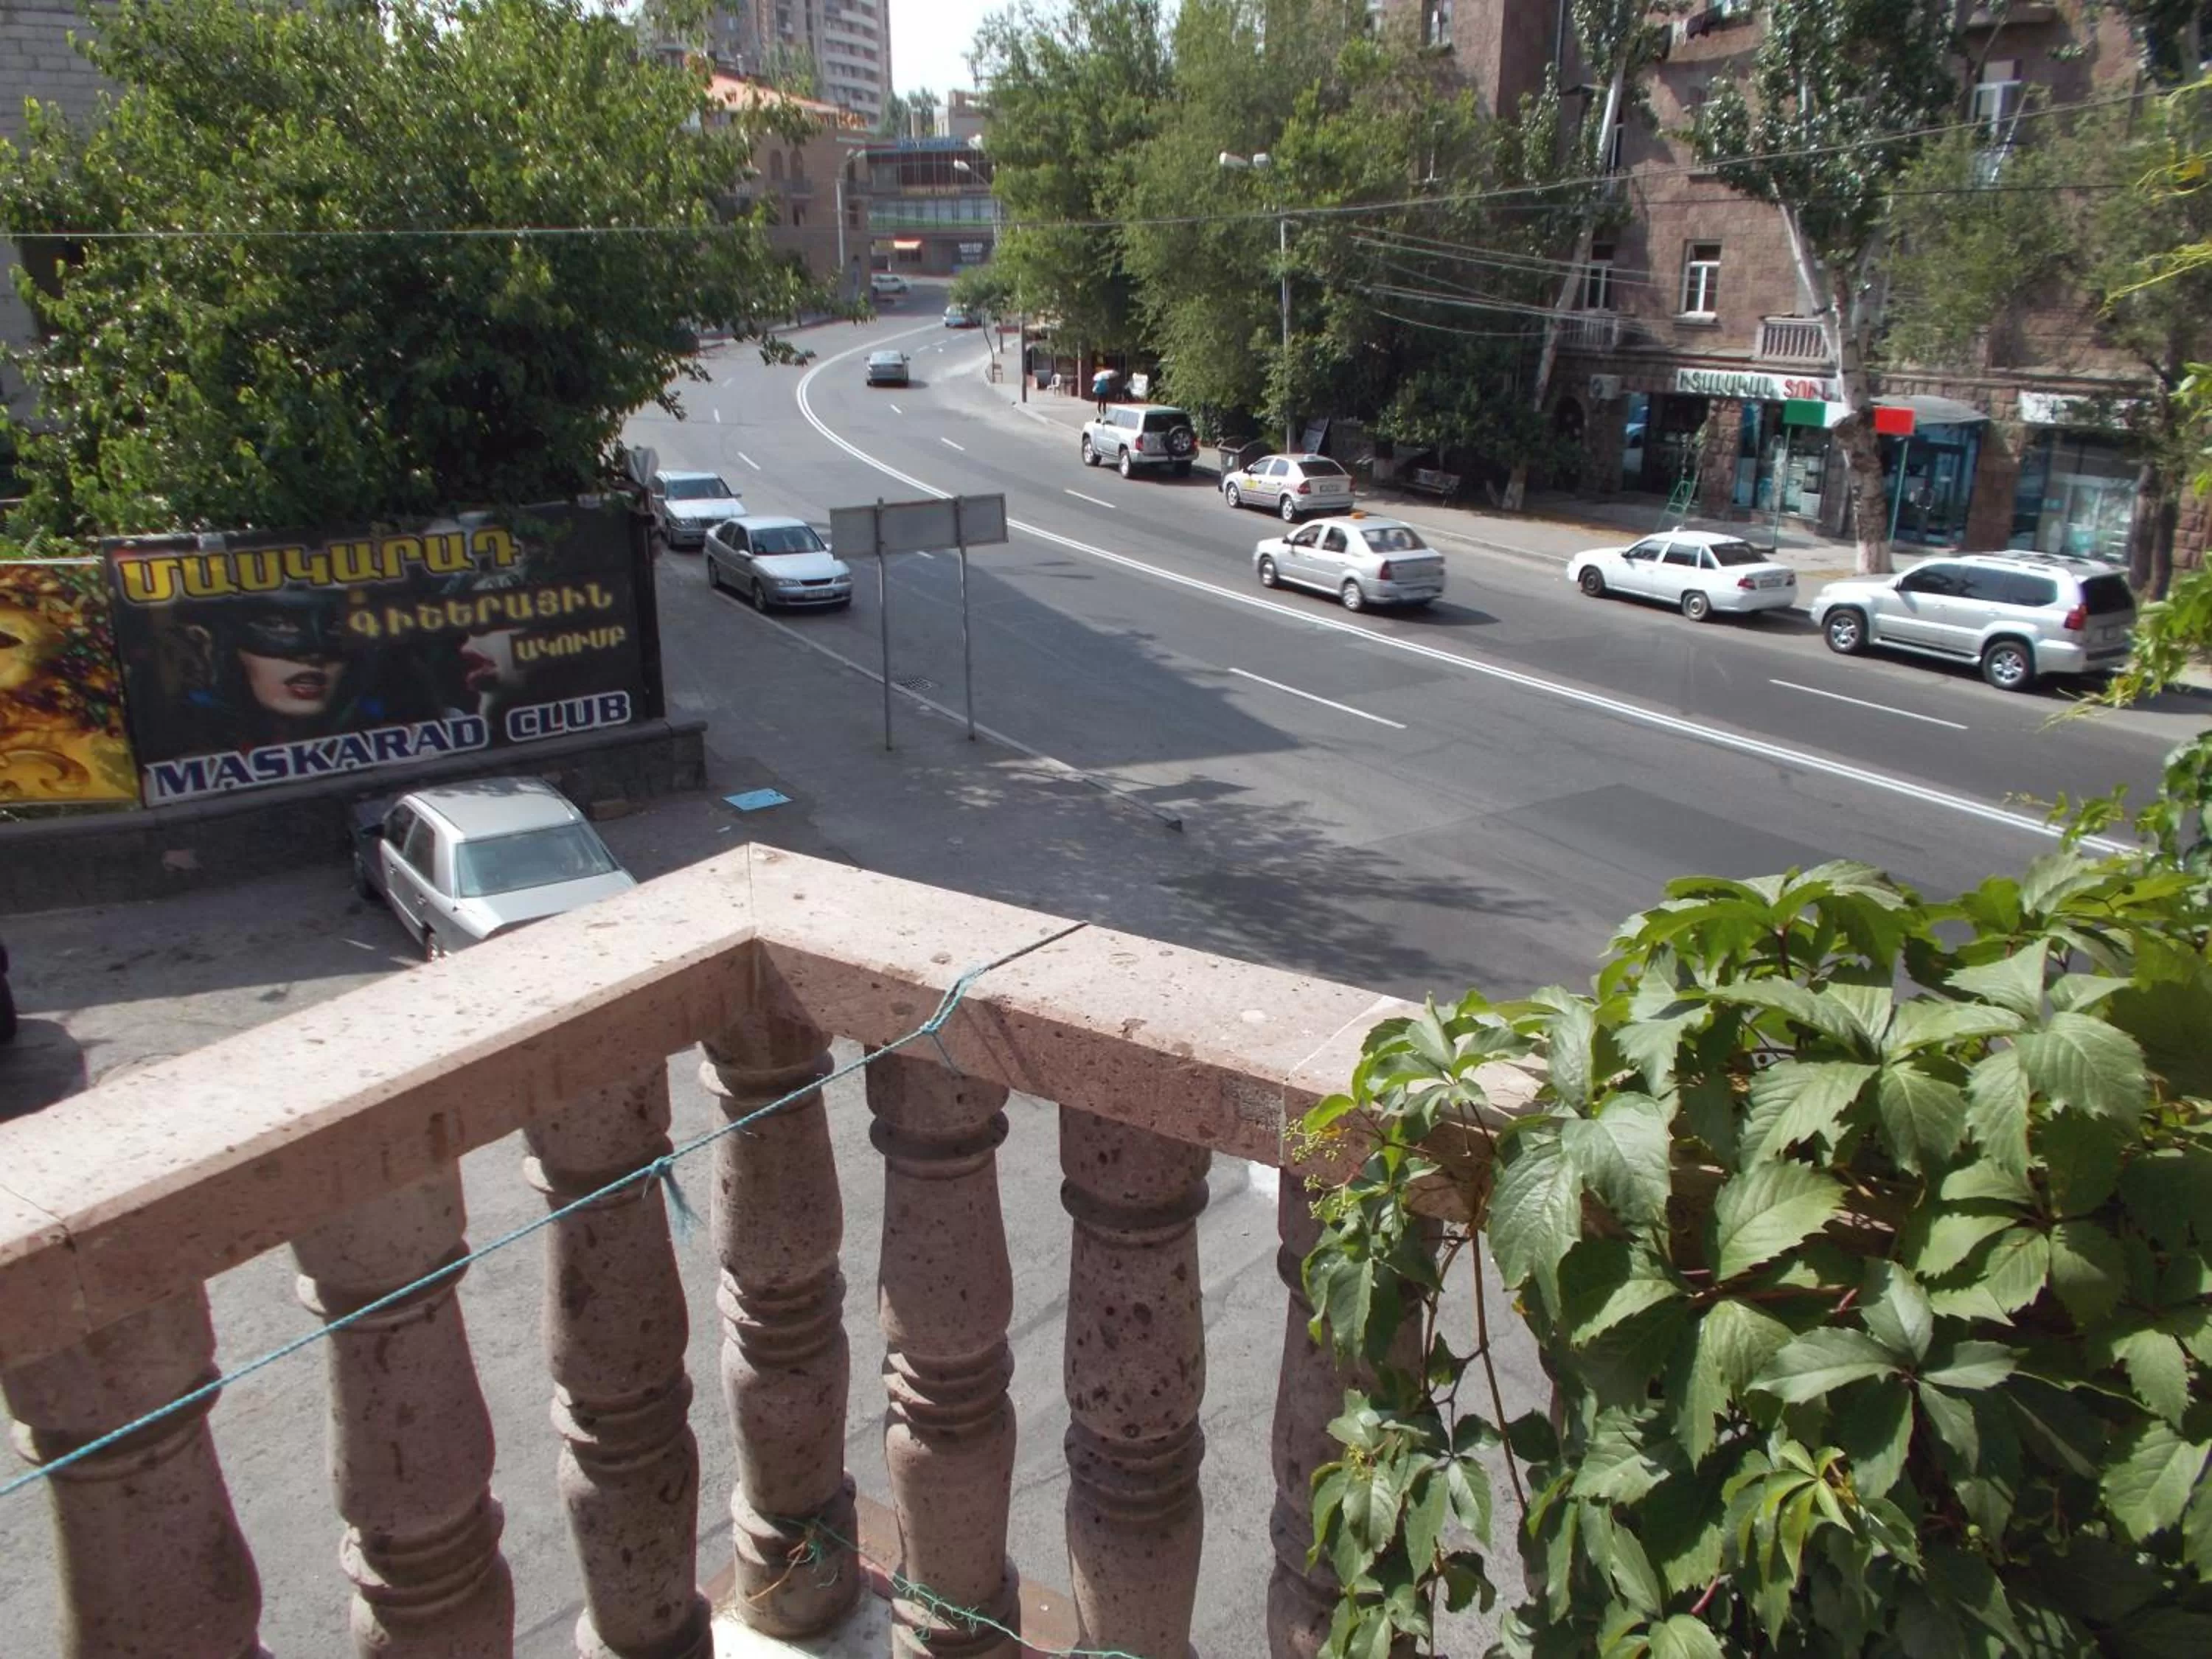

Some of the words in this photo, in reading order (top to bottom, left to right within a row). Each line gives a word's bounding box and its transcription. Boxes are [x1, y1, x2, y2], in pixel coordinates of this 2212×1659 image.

[118, 527, 520, 603] ՄԱՍԿԱՐԱԴ
[349, 582, 613, 639] ԳԻՇԵՐԱՅԻՆ
[516, 625, 625, 661] ԱԿՈՒՄԲ
[154, 716, 487, 796] MASKARAD
[508, 693, 629, 740] CLUB
